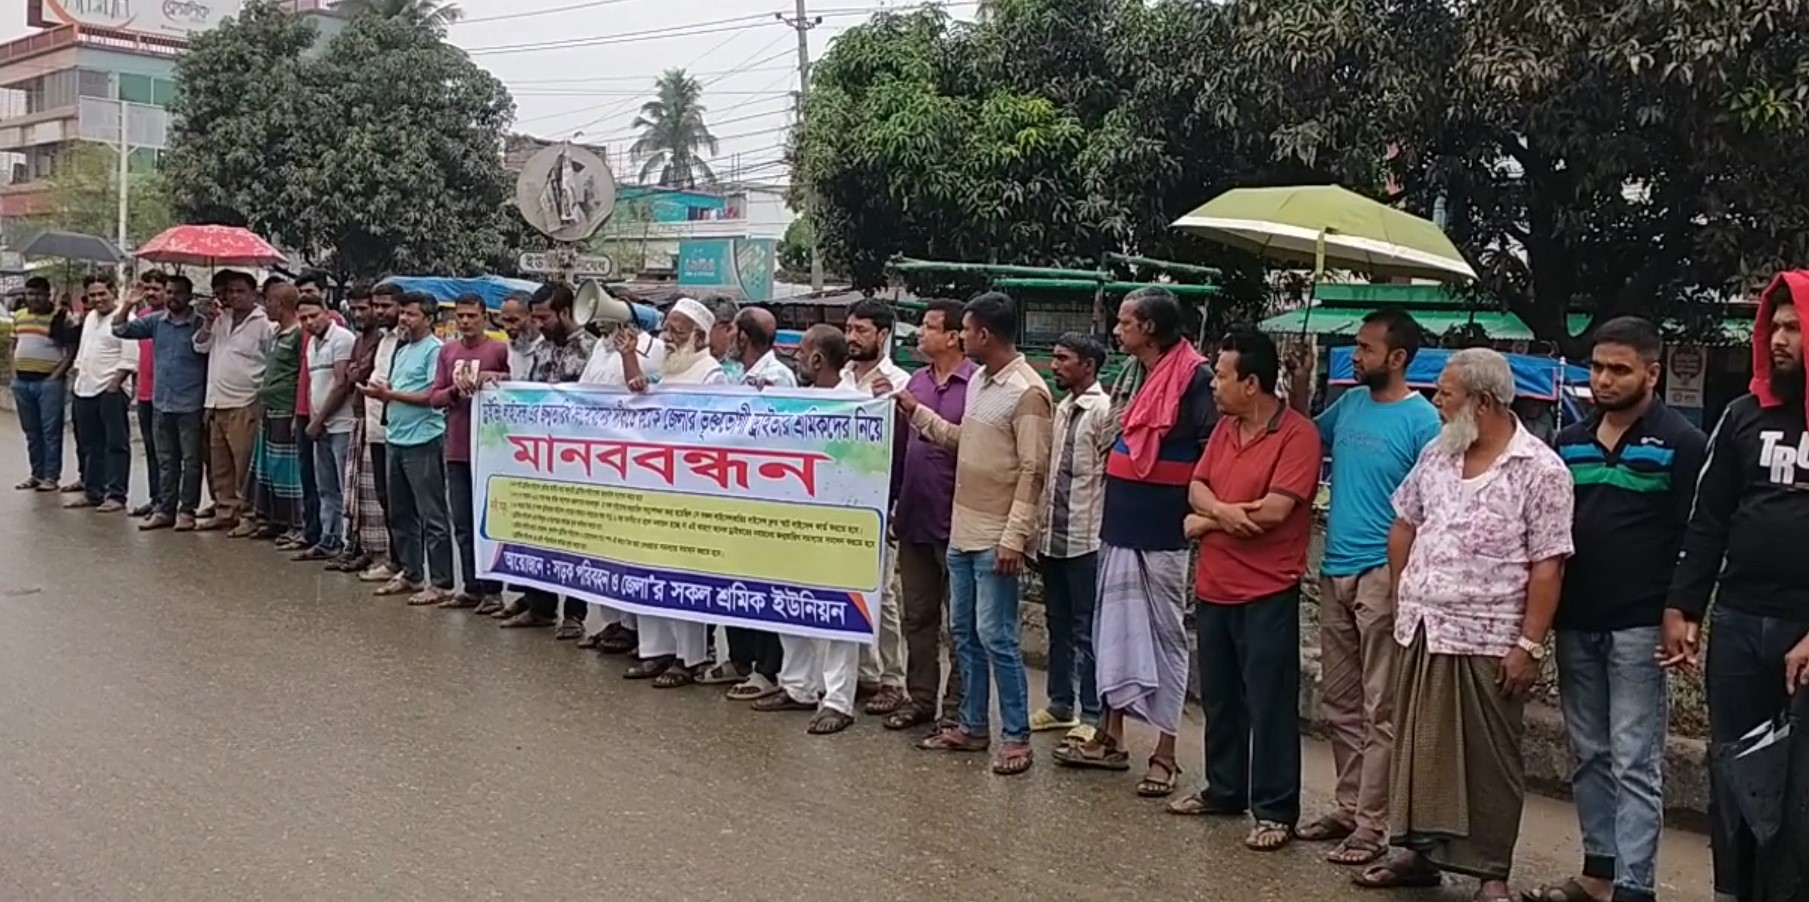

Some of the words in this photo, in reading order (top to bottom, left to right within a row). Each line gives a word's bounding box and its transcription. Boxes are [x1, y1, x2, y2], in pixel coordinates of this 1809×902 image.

[664, 407, 698, 431] জেলার
[794, 406, 851, 440] শ্রমিকদের
[854, 406, 884, 442] নিয়ে
[506, 434, 833, 497] মানববন্ধন
[503, 551, 544, 577] আয়োজনে
[552, 559, 574, 584] সড়ক
[575, 559, 610, 591] পরিবহন
[611, 573, 619, 591] ও
[669, 581, 712, 608] সকল
[716, 581, 767, 614] শ্রমিক
[770, 585, 847, 626] ইউনিয়ন
